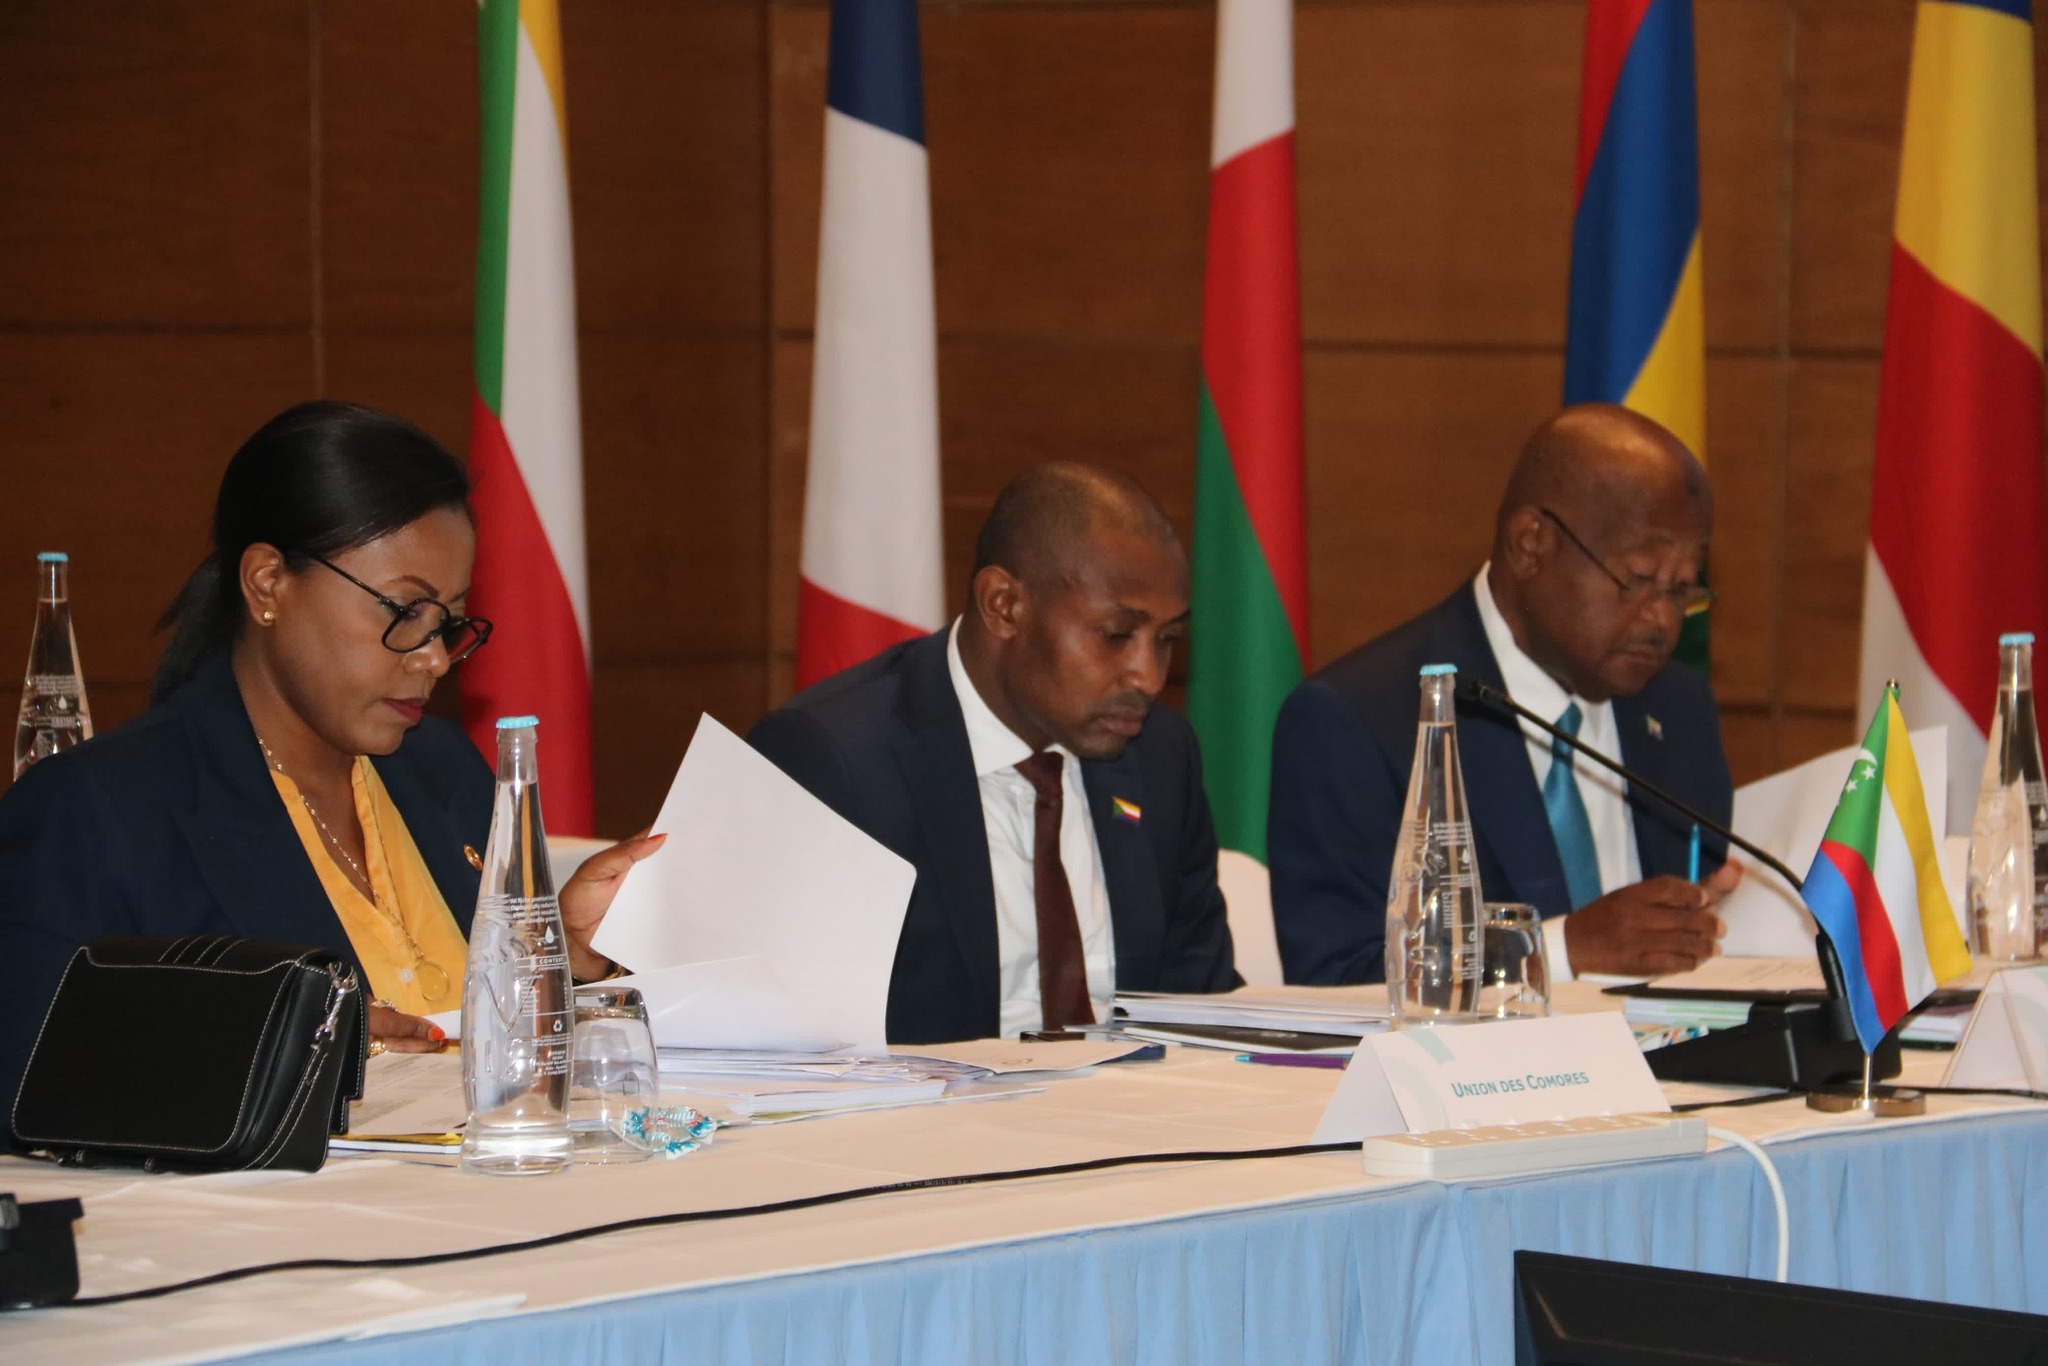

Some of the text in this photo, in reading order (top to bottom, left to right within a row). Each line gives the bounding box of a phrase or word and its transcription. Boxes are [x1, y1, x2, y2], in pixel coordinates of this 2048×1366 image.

[1451, 1072, 1589, 1098] UNION DES COMORES
